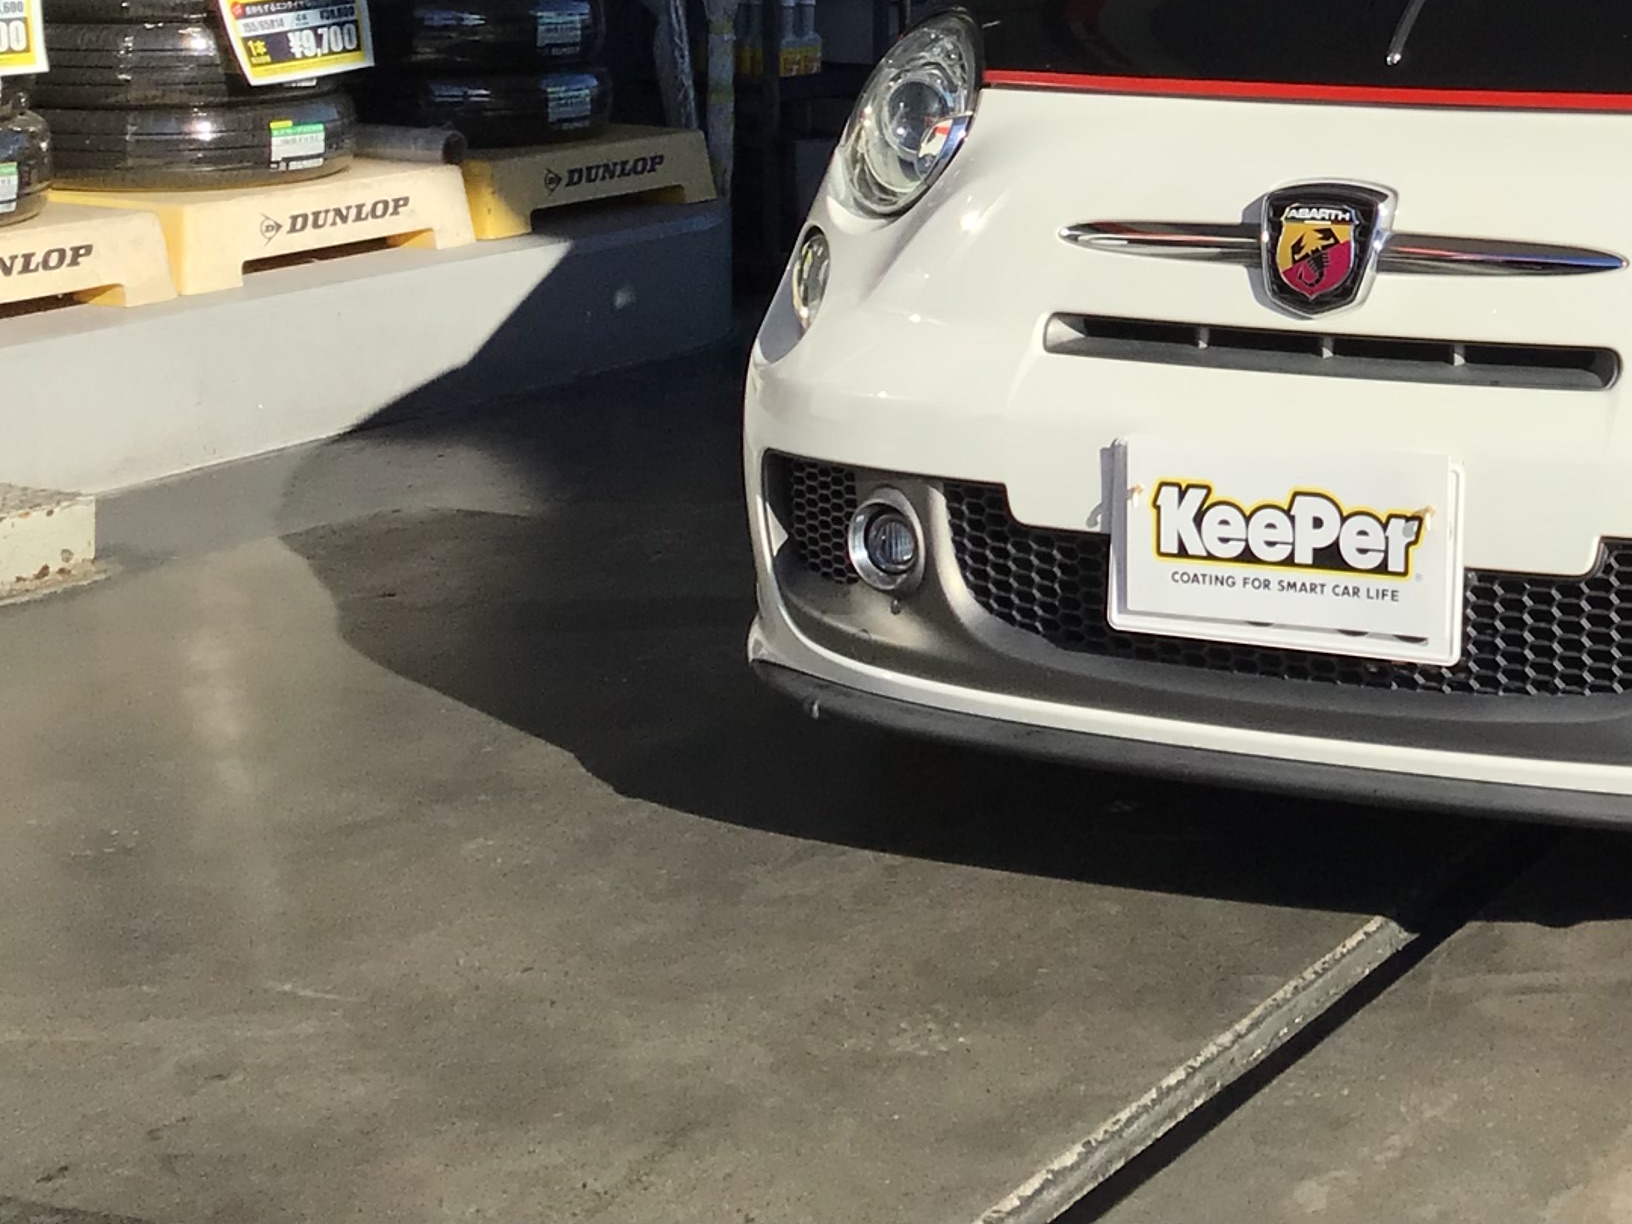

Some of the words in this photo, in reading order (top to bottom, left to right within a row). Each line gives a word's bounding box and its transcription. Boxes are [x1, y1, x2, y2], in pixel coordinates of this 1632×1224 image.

[287, 23, 358, 59] ¥9,700
[565, 154, 664, 188] DUNLOP
[286, 195, 409, 235] DUNLOP
[1287, 207, 1350, 222] ABARTH
[1153, 482, 1422, 577] KeePer
[1171, 570, 1236, 589] COATING
[1243, 576, 1271, 591] FOR
[1277, 579, 1327, 597] SMART
[1332, 583, 1360, 600] CAR
[1366, 587, 1400, 603] LIFE
